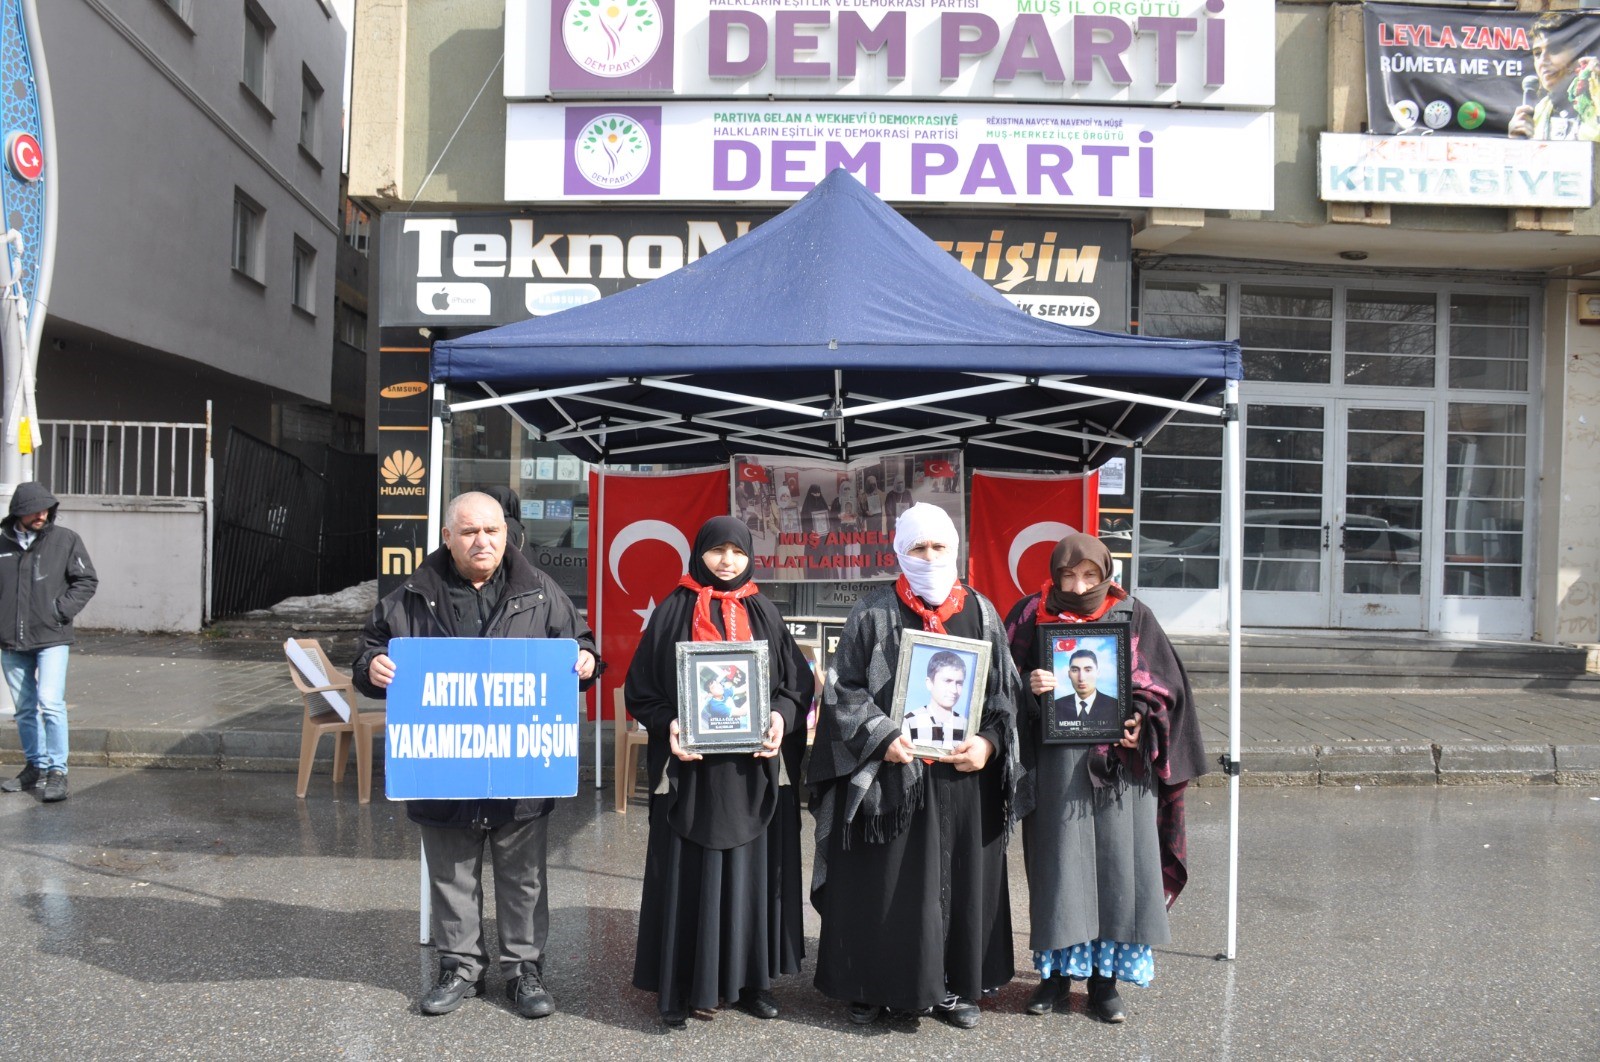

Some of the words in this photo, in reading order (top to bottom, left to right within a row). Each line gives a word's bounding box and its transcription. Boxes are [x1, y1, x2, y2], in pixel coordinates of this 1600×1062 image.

[1017, 0, 1060, 16] MUŞ
[708, 10, 906, 79] DEM
[940, 0, 1225, 87] PARTİ
[1378, 23, 1457, 48] LEYLA
[1461, 26, 1530, 50] ZANA
[584, 56, 607, 72] DEM
[1380, 53, 1456, 74] RÛMETA
[1460, 58, 1488, 75] ME
[1492, 59, 1522, 76] YE!
[763, 112, 802, 123] GELAN
[804, 113, 813, 123] A
[815, 112, 867, 124] WEKHEVÎ
[1093, 118, 1103, 127] YA
[713, 127, 779, 136] HALKLARIN
[781, 125, 824, 138] EŞİTLİK
[827, 127, 842, 138] VE
[844, 127, 910, 139] DEMOKRASİ
[914, 127, 958, 140] PARTİSİ
[1057, 129, 1080, 141] İLÇE
[1082, 130, 1124, 141] ÖRGÜTÜ
[713, 140, 881, 193] DEM
[910, 130, 1154, 198] PARTİ
[591, 172, 608, 184] DEM
[1038, 302, 1095, 317] SERVİS
[387, 385, 423, 394] SAMSUNG
[380, 487, 426, 496] HUAWEI
[779, 531, 821, 549] MUŞ
[834, 593, 858, 603] Mp3
[422, 672, 478, 707] ARTIK
[481, 672, 535, 707] YETER
[388, 723, 511, 759] YAKAMIZDAN
[516, 714, 578, 768] DÜŞÜN
